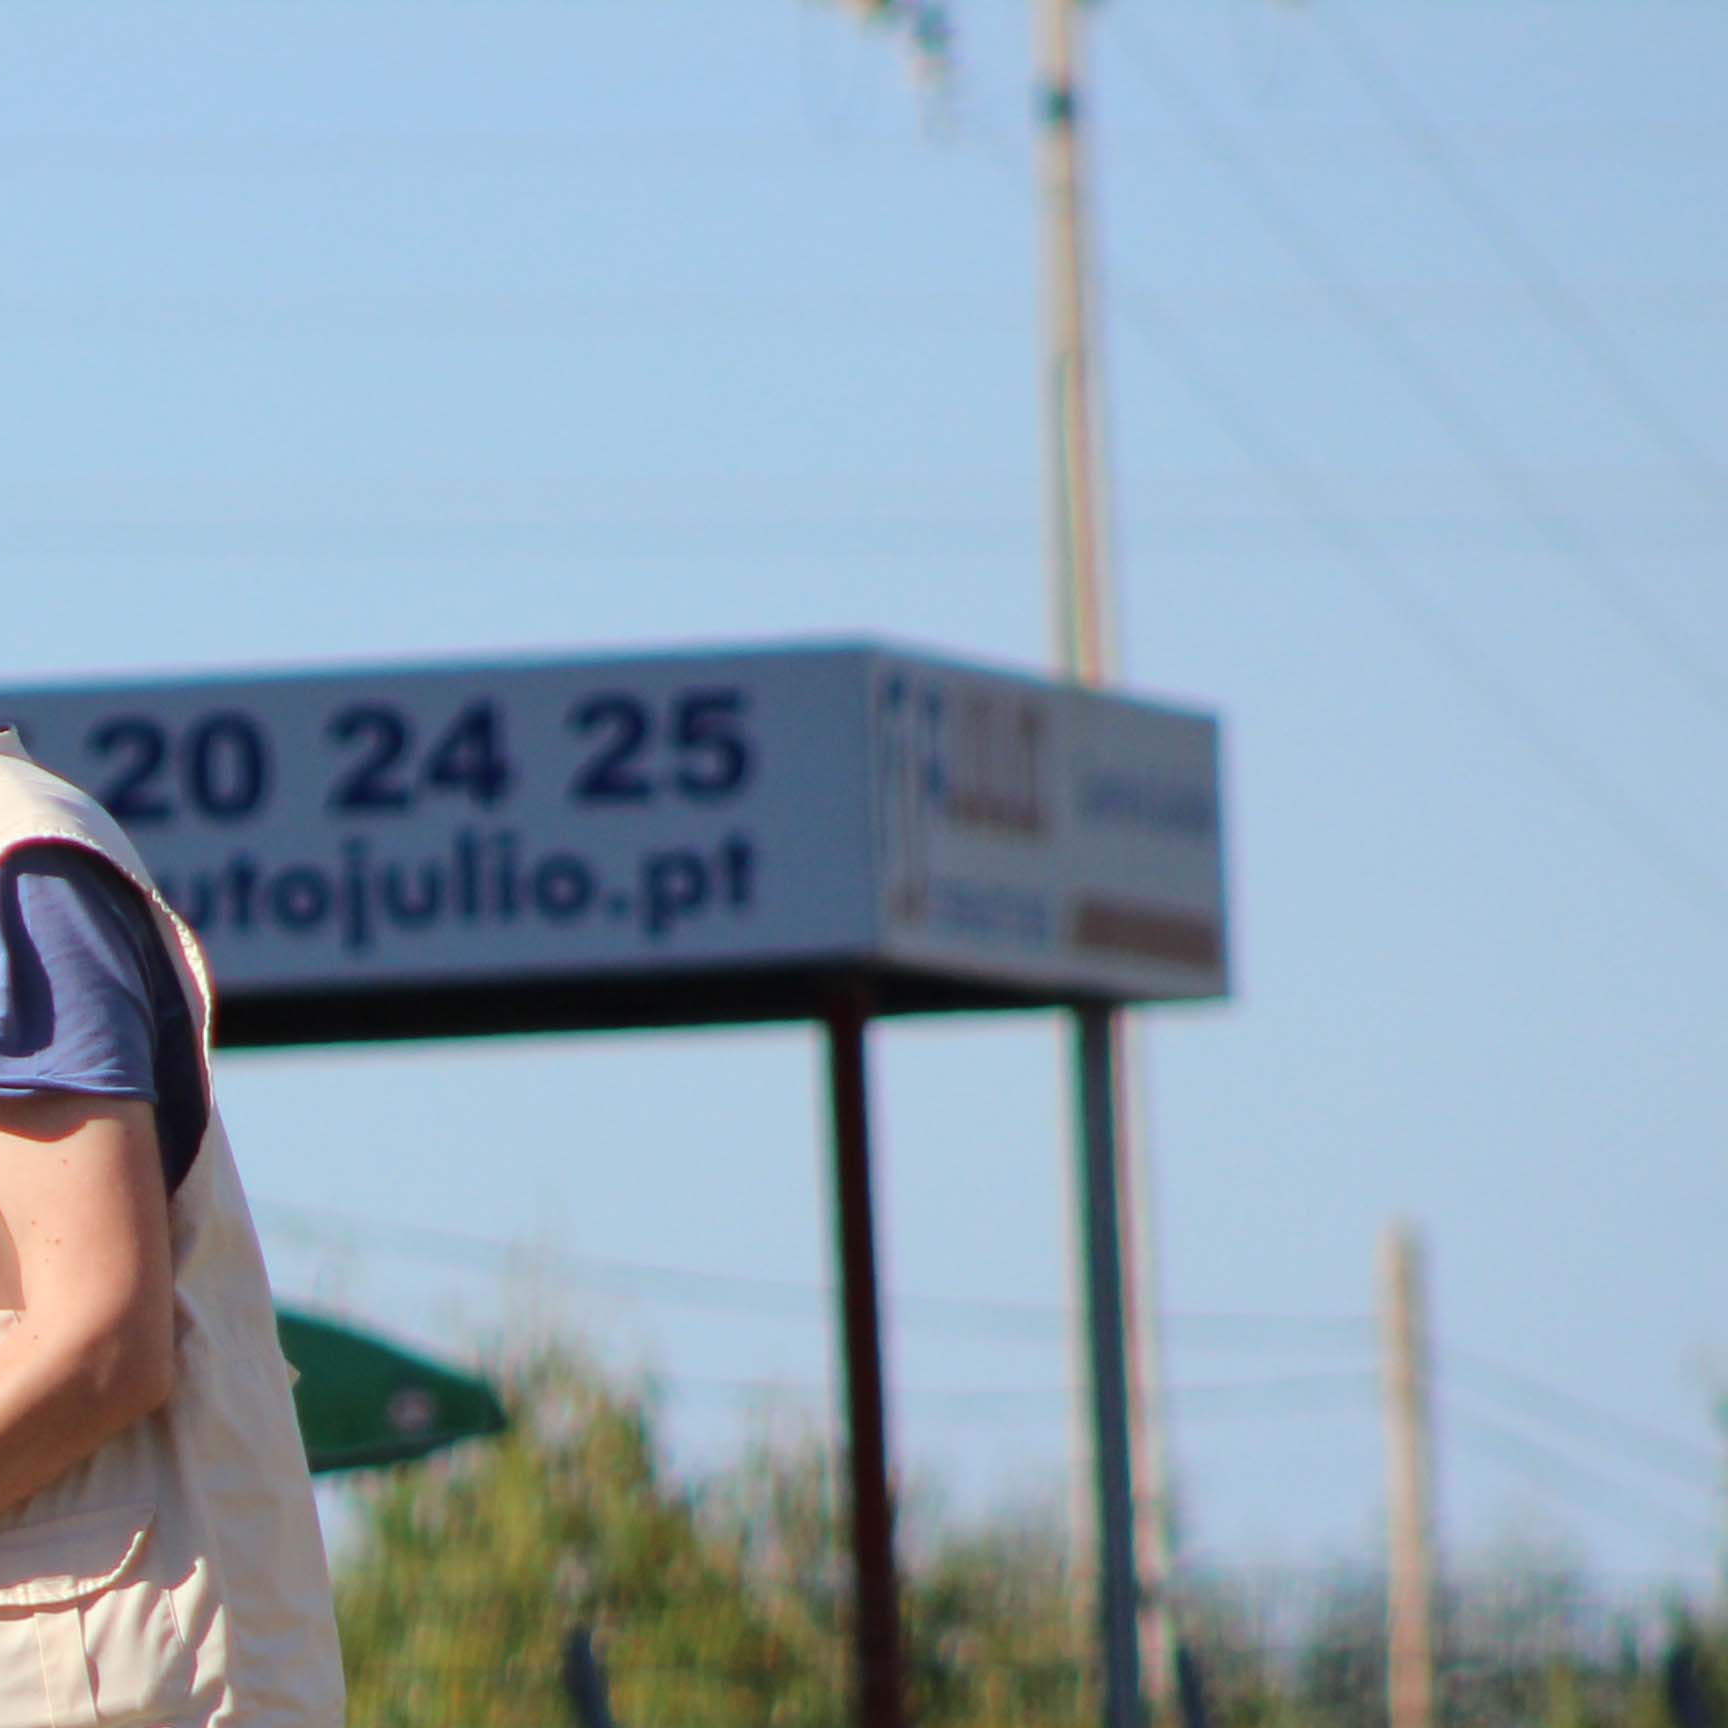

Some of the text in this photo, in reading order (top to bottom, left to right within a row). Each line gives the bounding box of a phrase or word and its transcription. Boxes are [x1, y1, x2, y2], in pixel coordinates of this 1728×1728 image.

[84, 684, 751, 826] 20 24 25
[159, 828, 754, 956] utojulio.pt
